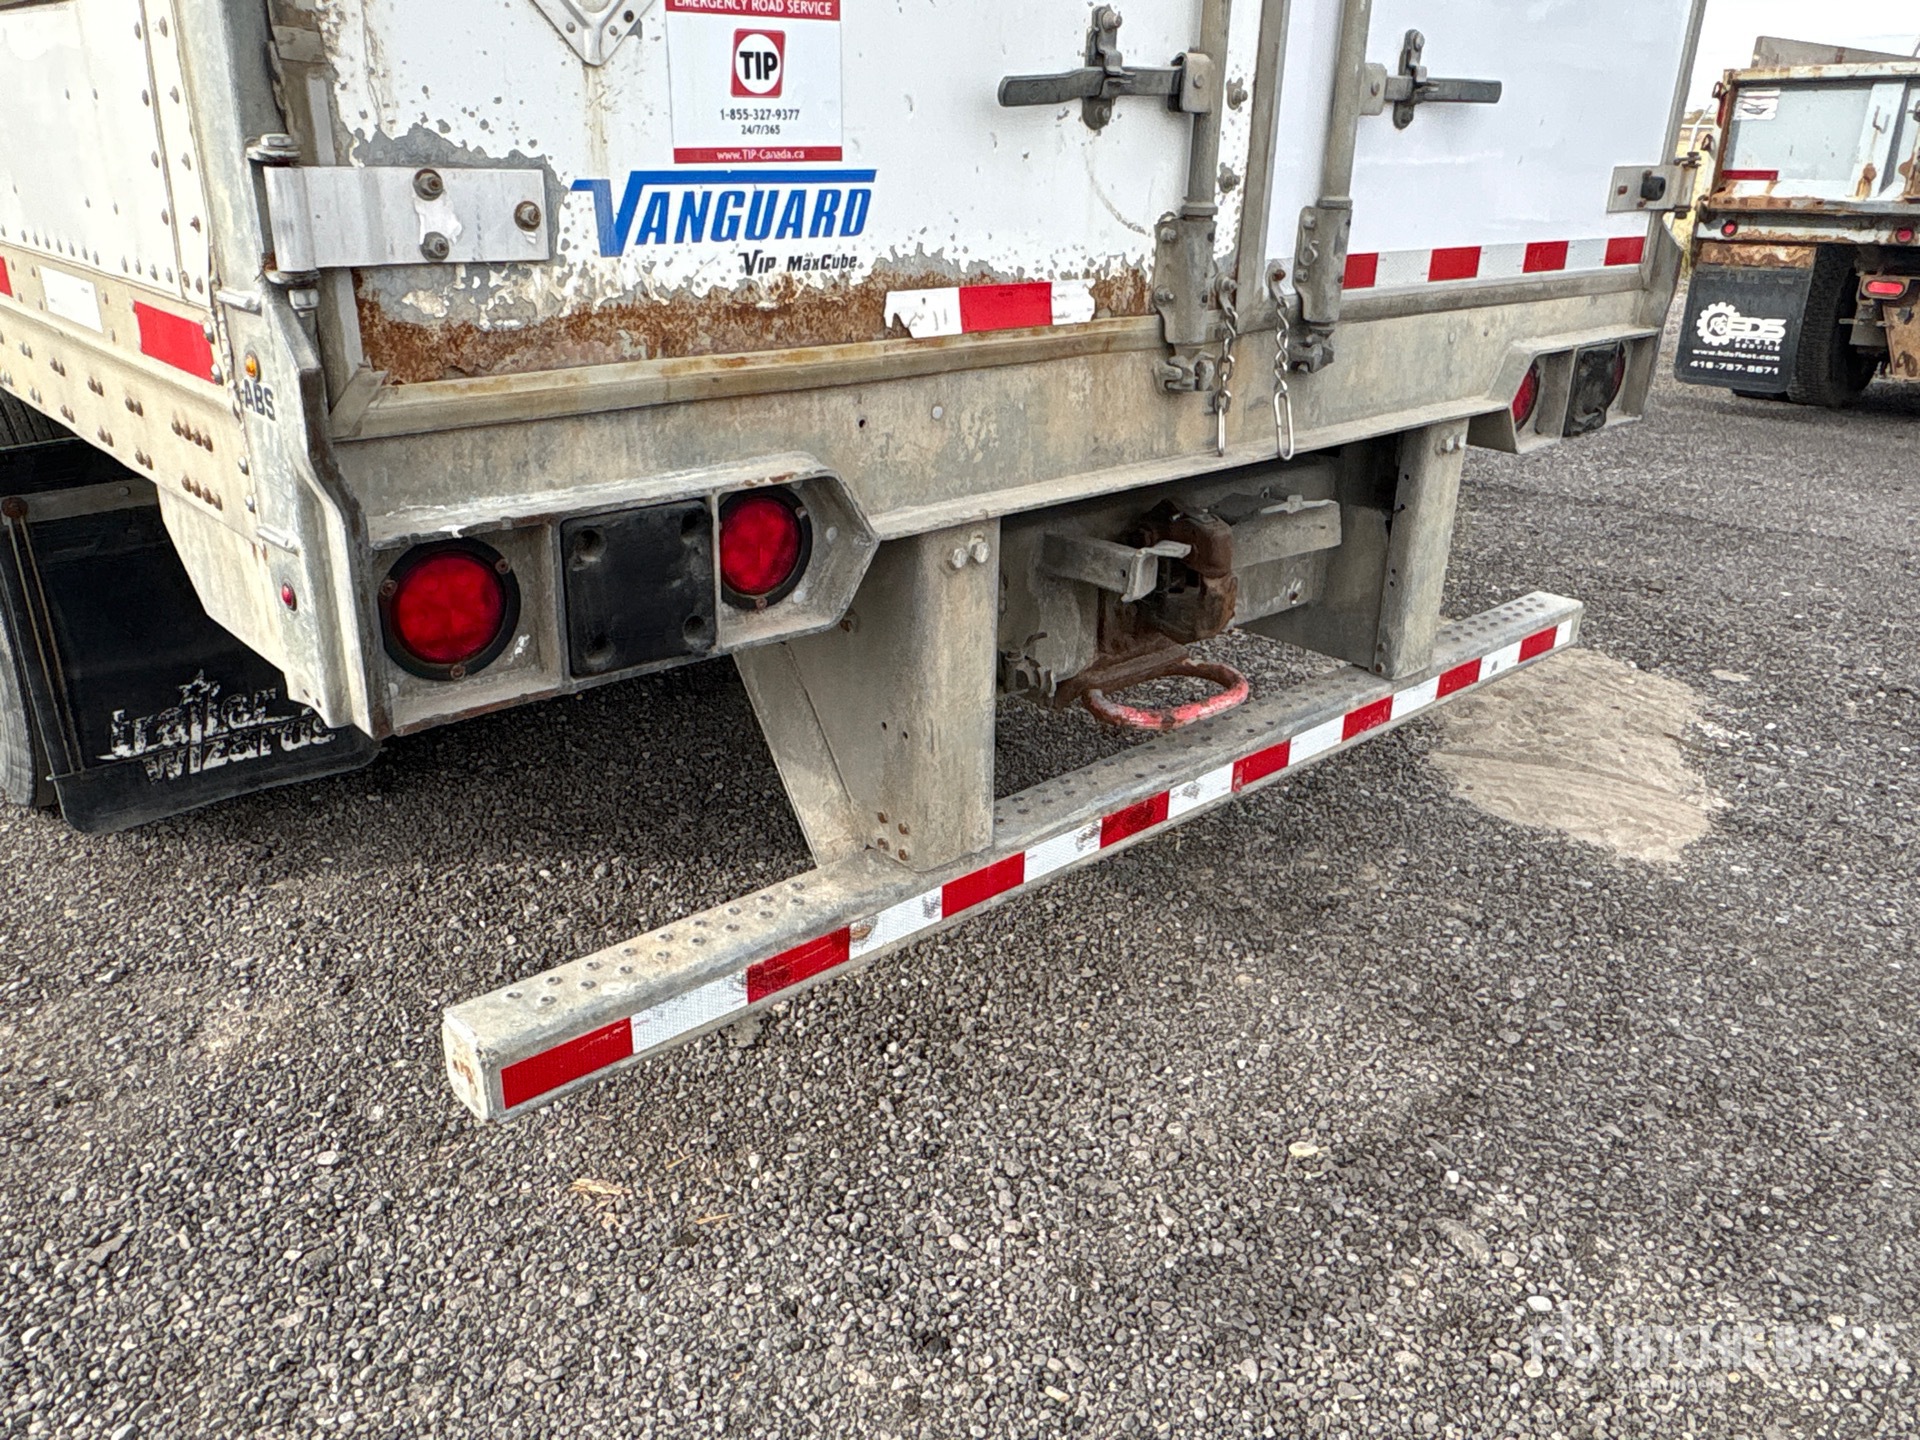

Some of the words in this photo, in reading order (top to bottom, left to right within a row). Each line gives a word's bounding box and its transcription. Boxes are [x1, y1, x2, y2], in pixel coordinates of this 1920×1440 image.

[674, 0, 747, 11] EMERGENCY
[752, 0, 784, 13] ROAD
[787, 1, 832, 16] SERVICE
[739, 51, 778, 80] TIP
[720, 108, 800, 121] 1-855-327-9377
[741, 124, 781, 135] 24/7/365
[716, 149, 805, 160] www.TIP-Canada.ca
[570, 169, 878, 258] VANGUARD
[786, 253, 858, 272] MaxCube
[244, 378, 276, 421] ABS
